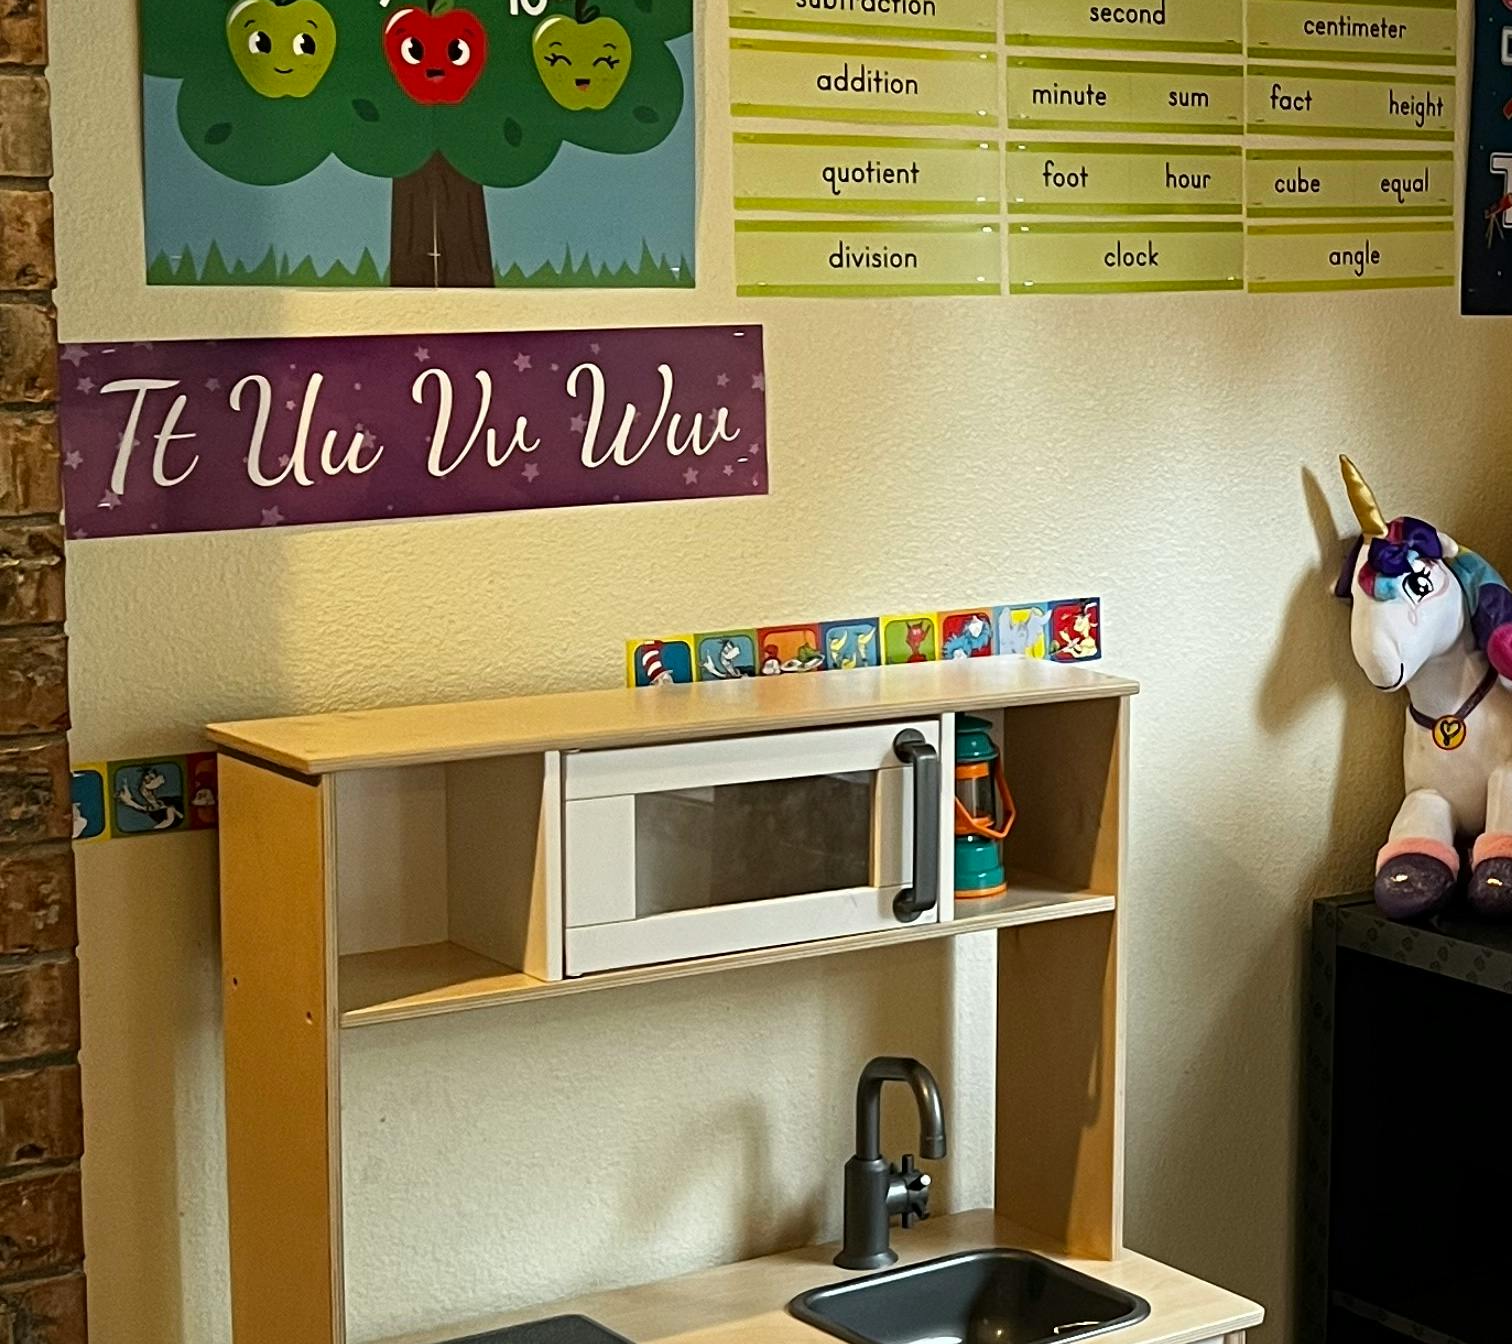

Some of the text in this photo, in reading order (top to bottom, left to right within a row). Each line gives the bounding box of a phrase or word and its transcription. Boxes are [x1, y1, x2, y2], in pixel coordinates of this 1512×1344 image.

[1303, 15, 1407, 39] centimeter
[816, 63, 918, 94] addition
[1032, 83, 1107, 107] minute
[1168, 89, 1209, 108] sum
[1270, 83, 1313, 112] fact
[1389, 89, 1444, 128] height
[822, 161, 920, 196] quotient
[1042, 160, 1088, 189] foot
[1165, 162, 1211, 190] hour
[1274, 168, 1321, 194] cube
[1381, 168, 1429, 204] equal
[829, 241, 917, 268] division
[1104, 240, 1159, 268] clock
[1329, 240, 1381, 276] angle
[99, 362, 741, 496] Tt Uu Vv Ww
